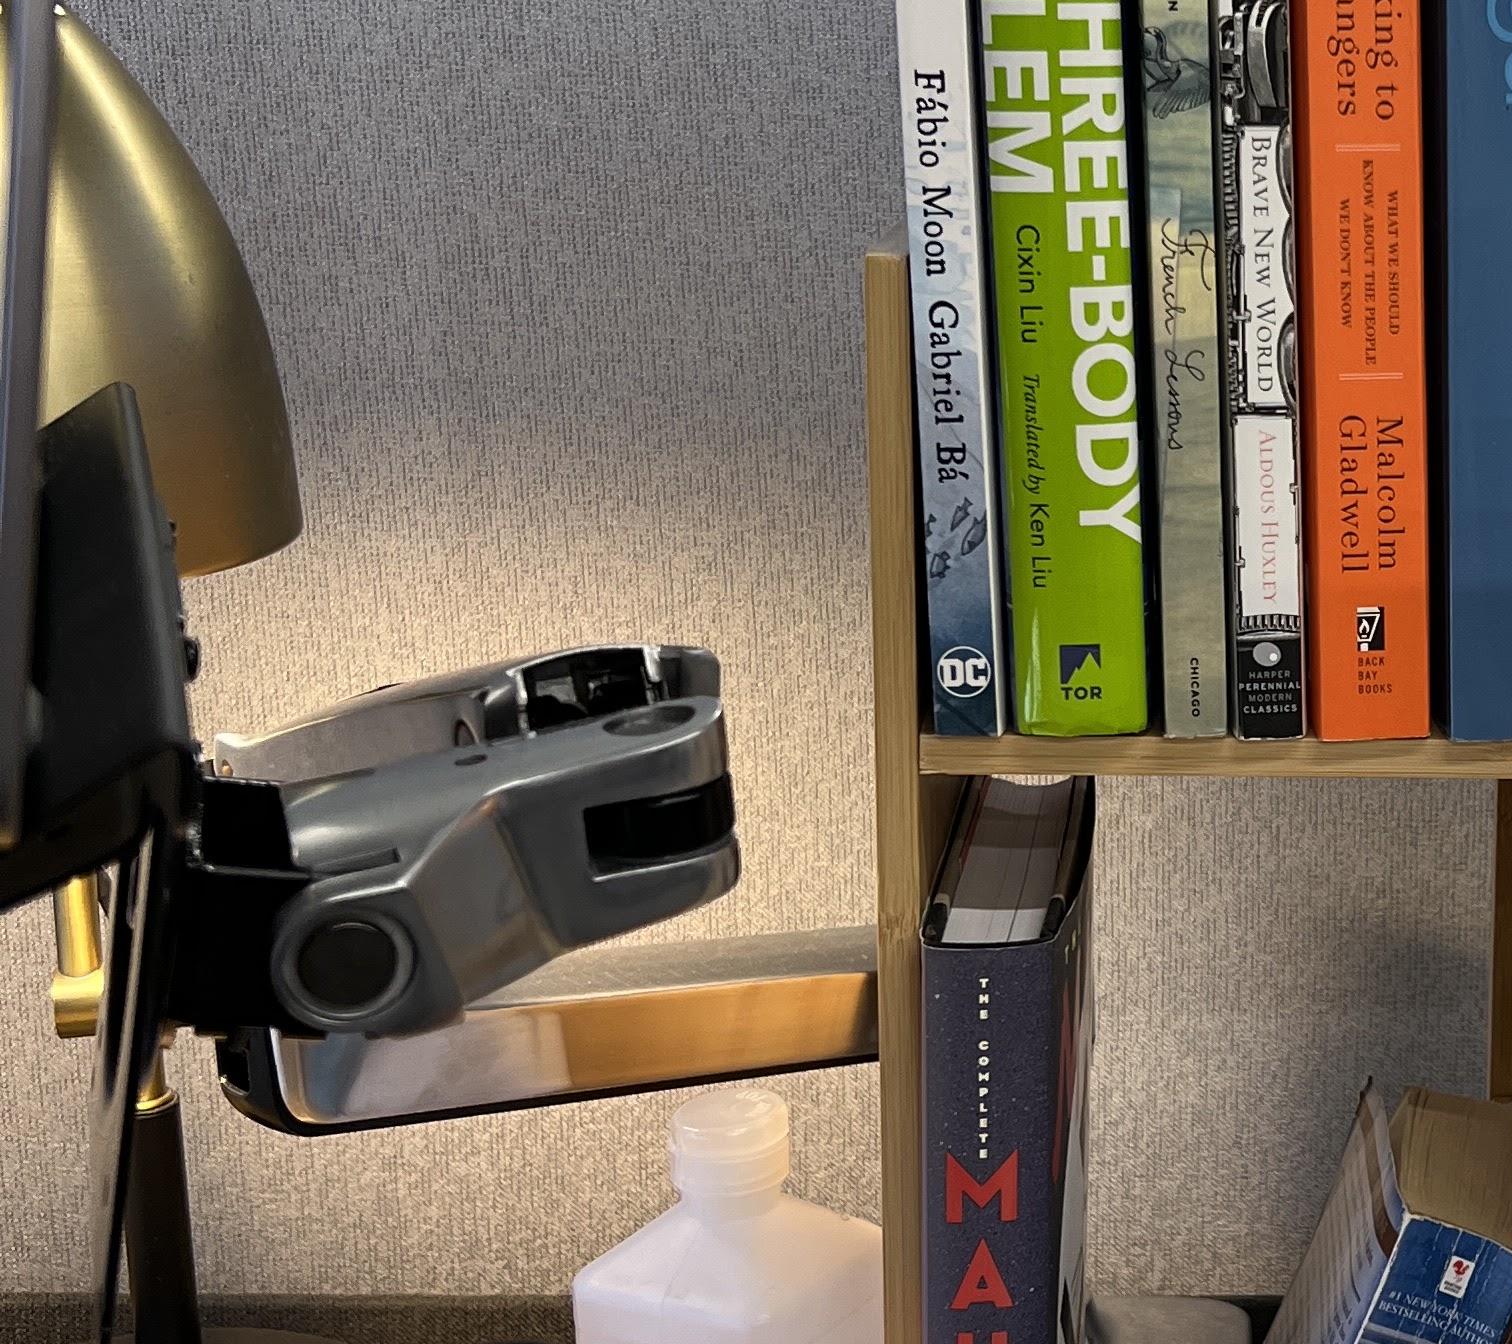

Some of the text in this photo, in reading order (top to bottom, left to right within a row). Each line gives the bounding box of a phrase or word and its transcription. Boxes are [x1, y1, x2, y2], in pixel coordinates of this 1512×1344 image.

[1374, 84, 1400, 122] to
[1339, 197, 1351, 226] WE
[913, 68, 969, 484] Fábio Moon Gabriel Bá
[1015, 224, 1043, 344] Cixin Liu
[1250, 135, 1277, 393] BRAVE NEW WORLD
[1362, 159, 1378, 367] KNOW ABOUT THE PEOPLE
[1386, 189, 1401, 336] WHAT WE SHOULD
[1340, 282, 1353, 329] KNOW
[1160, 218, 1216, 451] French Lessons
[1021, 373, 1052, 589] Translated by Ken Liu
[1338, 414, 1370, 574] Gladwell
[1375, 415, 1406, 571] Malcolm
[1257, 429, 1280, 603] ALDOUS HUXLEY
[942, 657, 988, 688] DC
[1248, 669, 1291, 680] HARPER
[1357, 656, 1386, 668] BACK
[1357, 670, 1378, 681] BAY
[1060, 687, 1103, 700] TOR
[1189, 657, 1201, 719] CHICAGO
[1238, 681, 1301, 692] PERENNIAL
[1243, 703, 1298, 715] CLASSICS
[1248, 692, 1293, 703] MODERN
[1357, 683, 1393, 695] BOOKS
[977, 977, 990, 1159] THE COMPLETE
[1378, 1300, 1451, 1330] BESTSELLING
[1388, 1290, 1499, 1338] #1 NEW YORK TIMES
